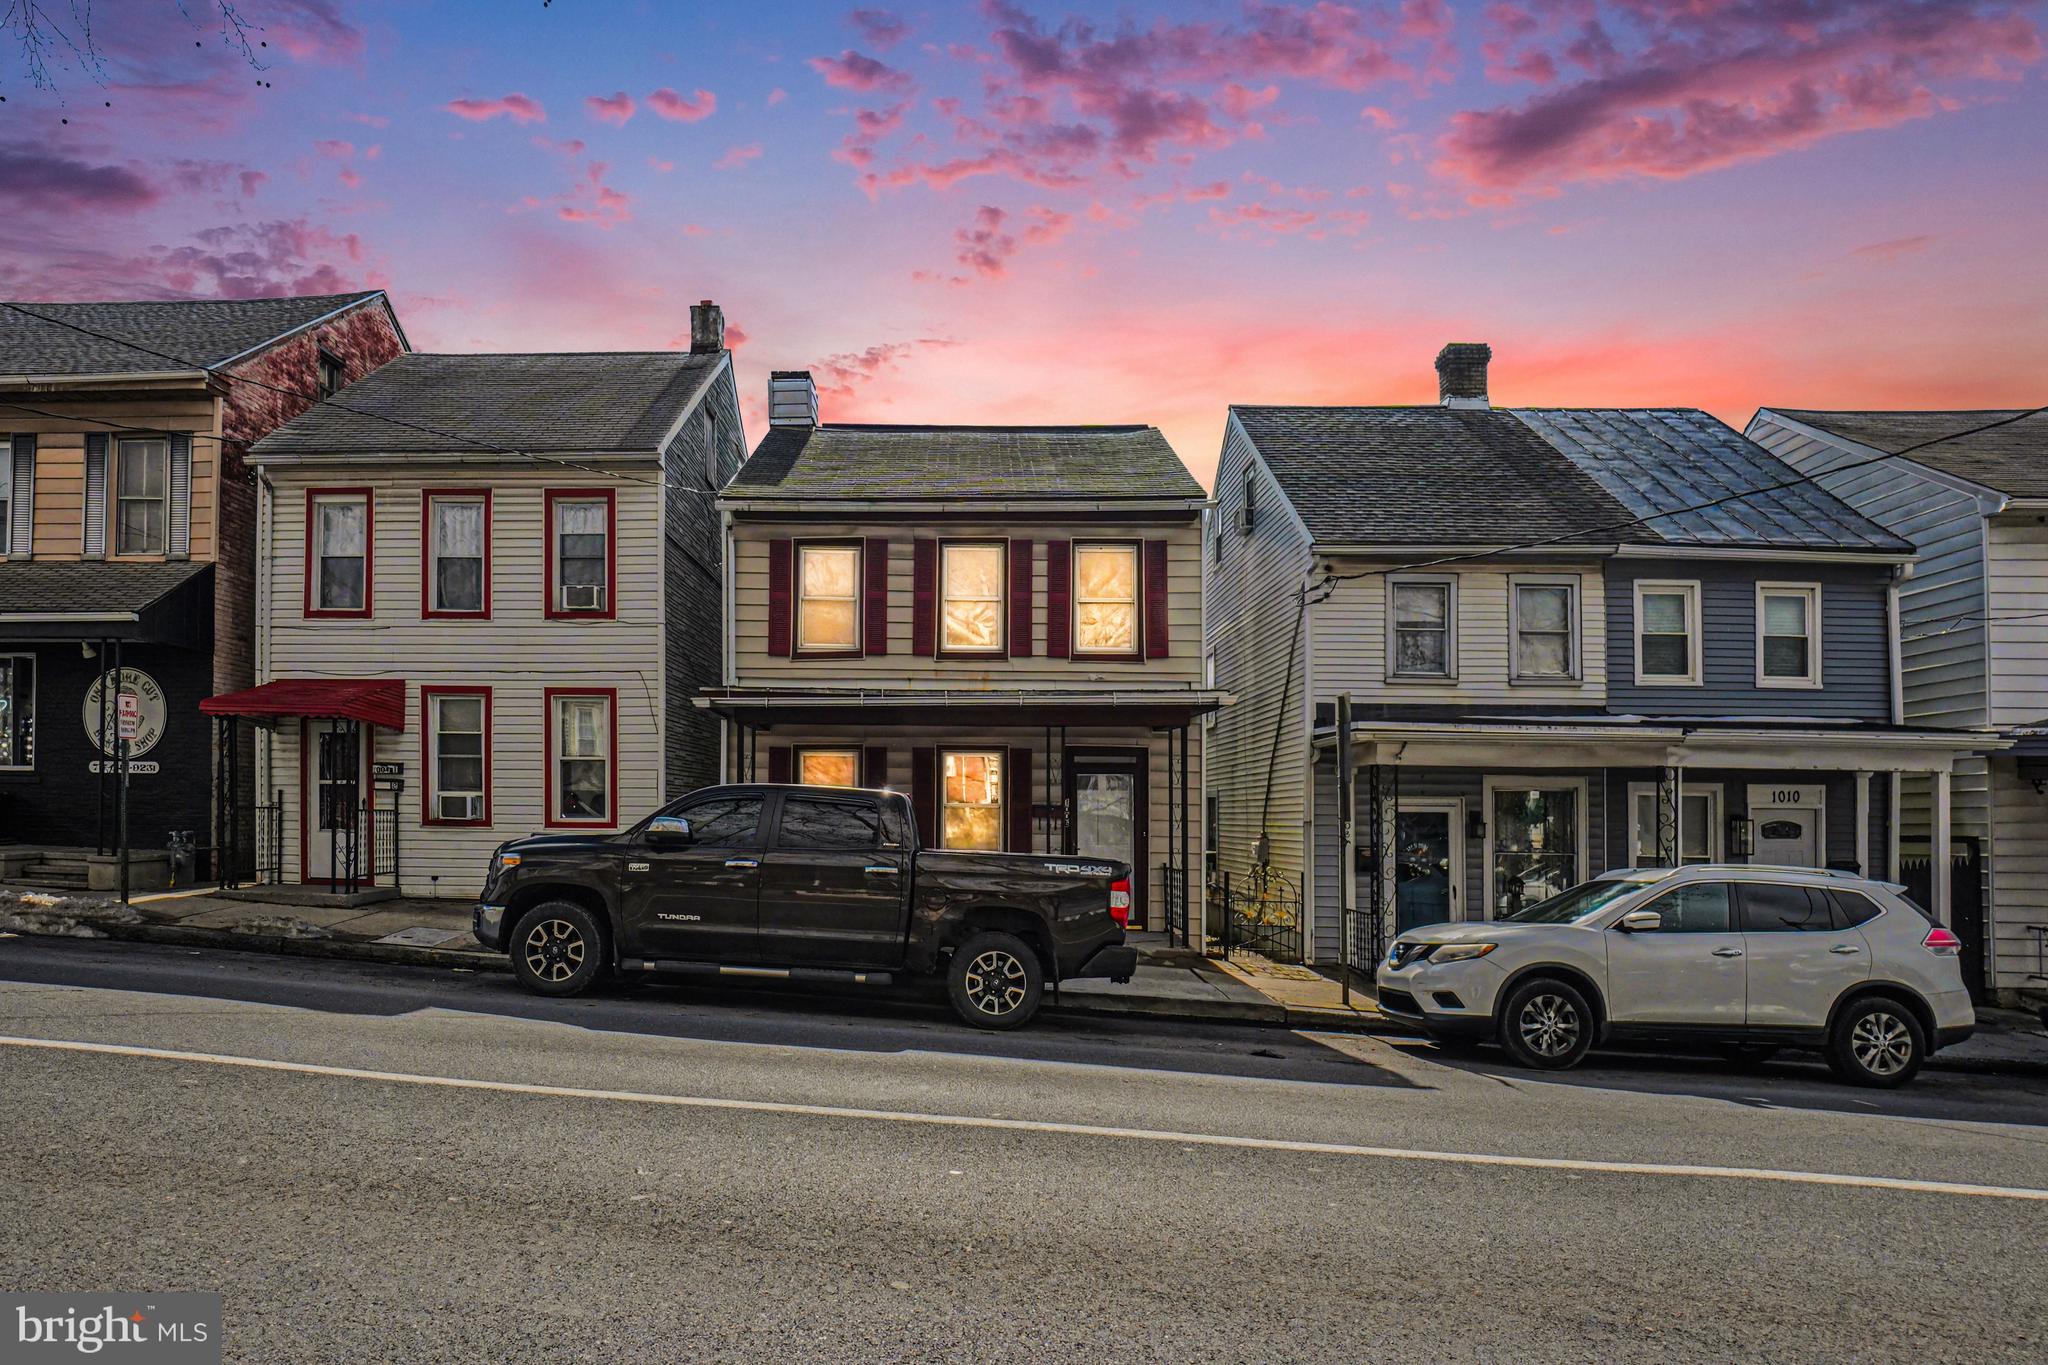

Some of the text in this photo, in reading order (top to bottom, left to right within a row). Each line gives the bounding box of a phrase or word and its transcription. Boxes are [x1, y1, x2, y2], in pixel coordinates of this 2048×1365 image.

[141, 681, 160, 702] CUT
[135, 727, 157, 751] SHOP
[1772, 790, 1800, 803] 1010
[1044, 863, 1080, 874] TRD
[657, 913, 701, 921] TUNDRA
